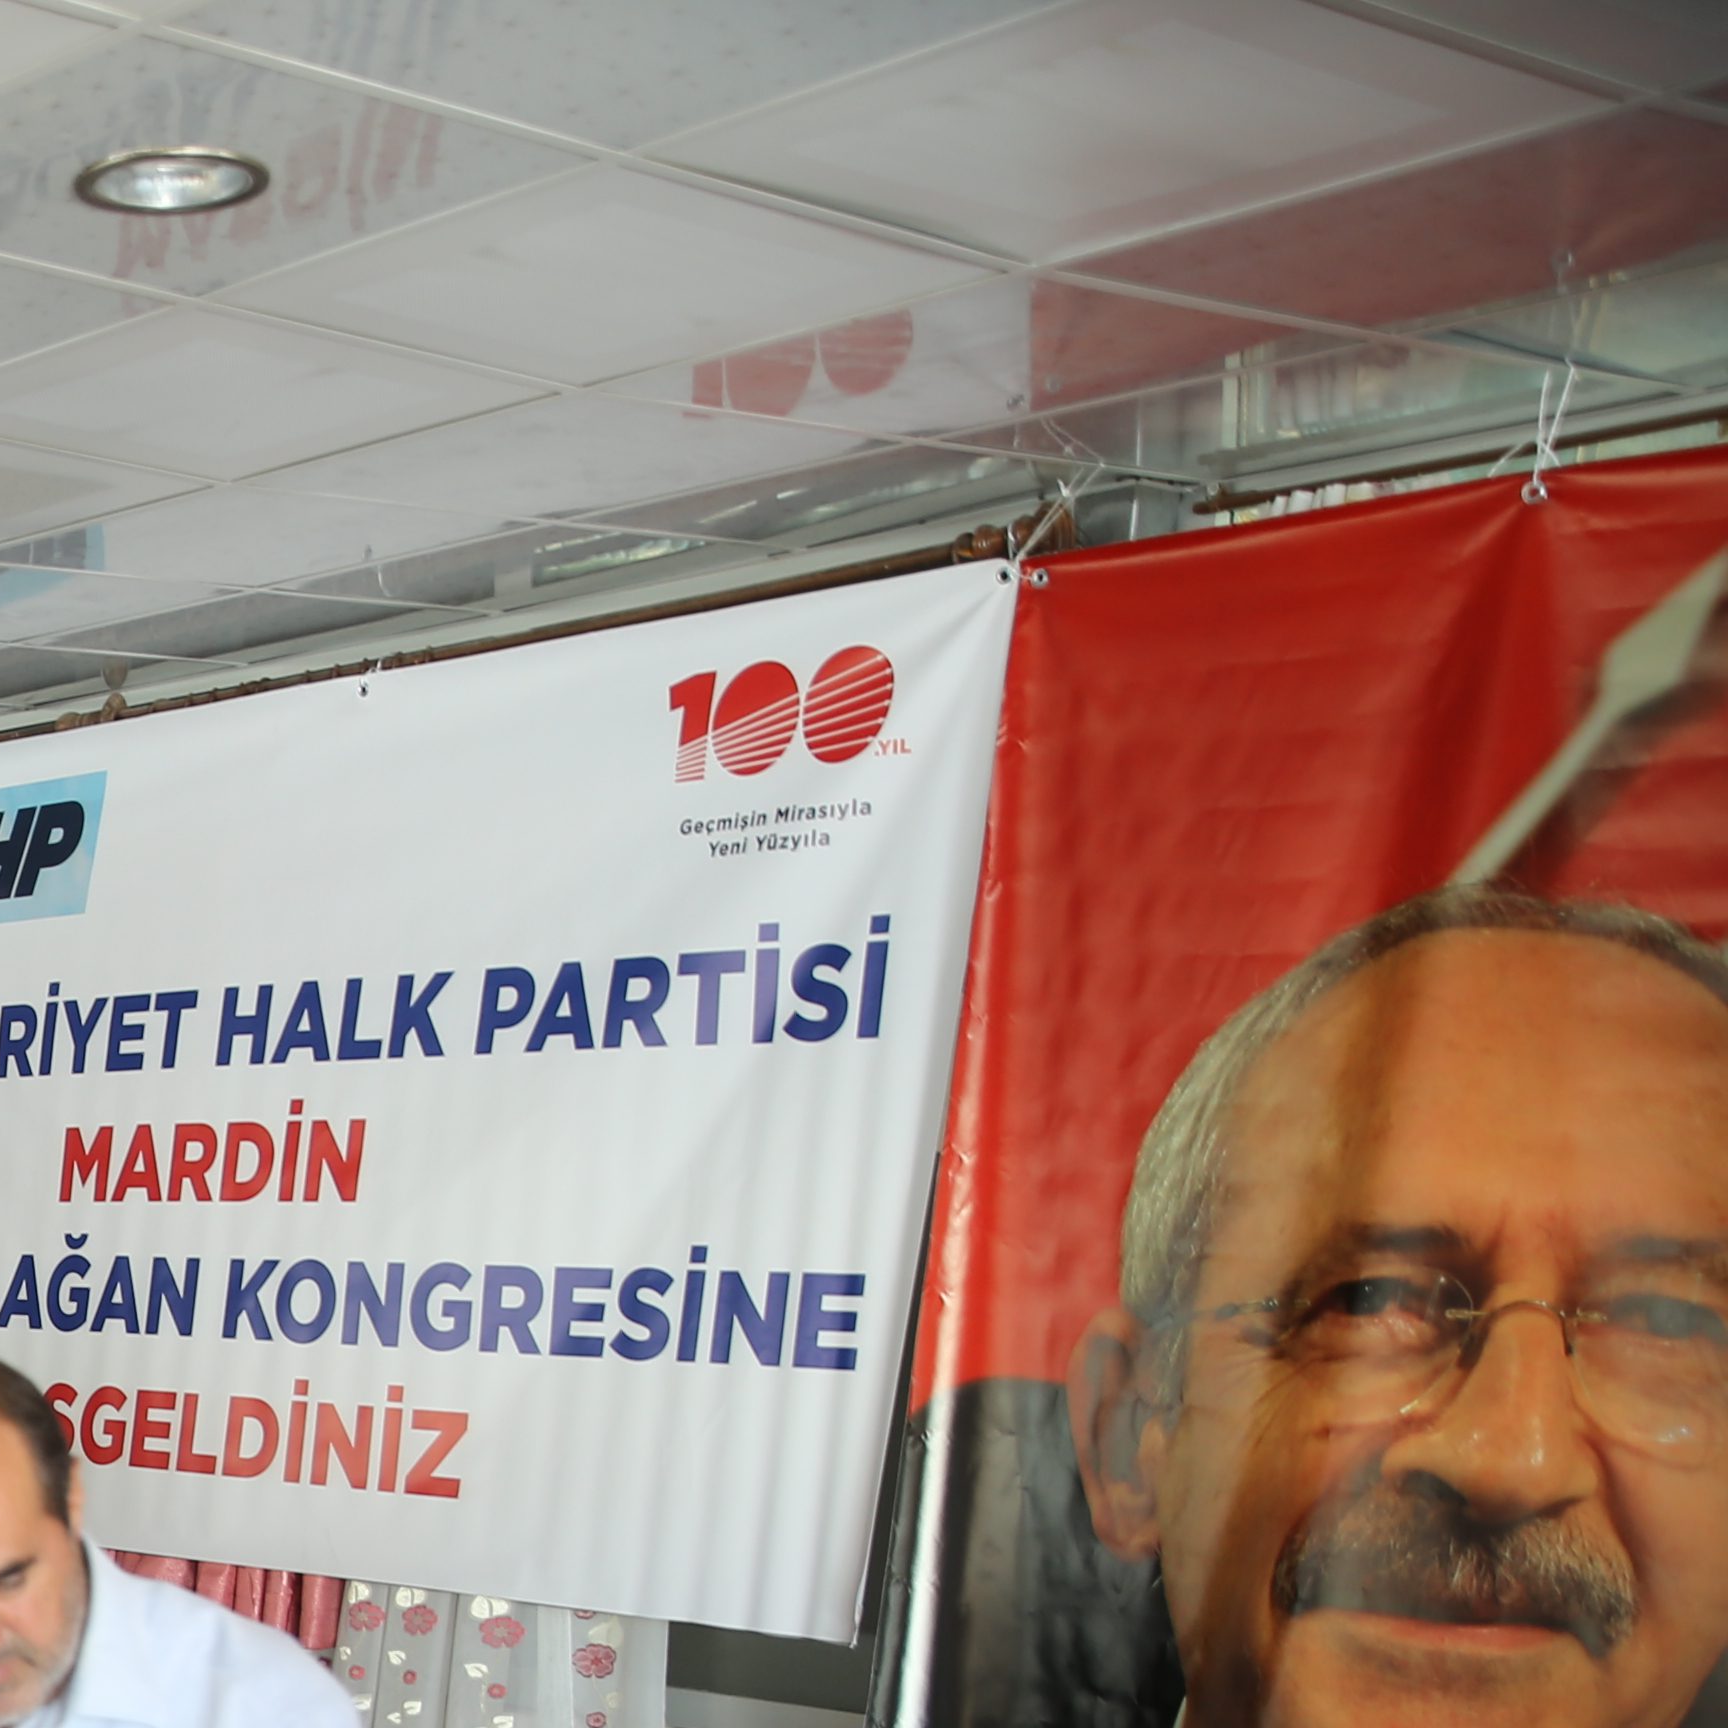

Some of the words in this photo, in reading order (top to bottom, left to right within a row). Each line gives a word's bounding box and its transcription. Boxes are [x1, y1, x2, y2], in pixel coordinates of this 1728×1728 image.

[669, 645, 895, 783] 100
[680, 811, 767, 836] Geçmişin
[774, 798, 872, 824] Mirasıyla
[709, 840, 748, 858] Yeni
[756, 829, 830, 851] Yüzyıla
[215, 971, 454, 1067] HALK
[474, 914, 890, 1055] PARTİSİ
[59, 1099, 366, 1202] MARDİN
[221, 1245, 865, 1371] KONGRESİNE
